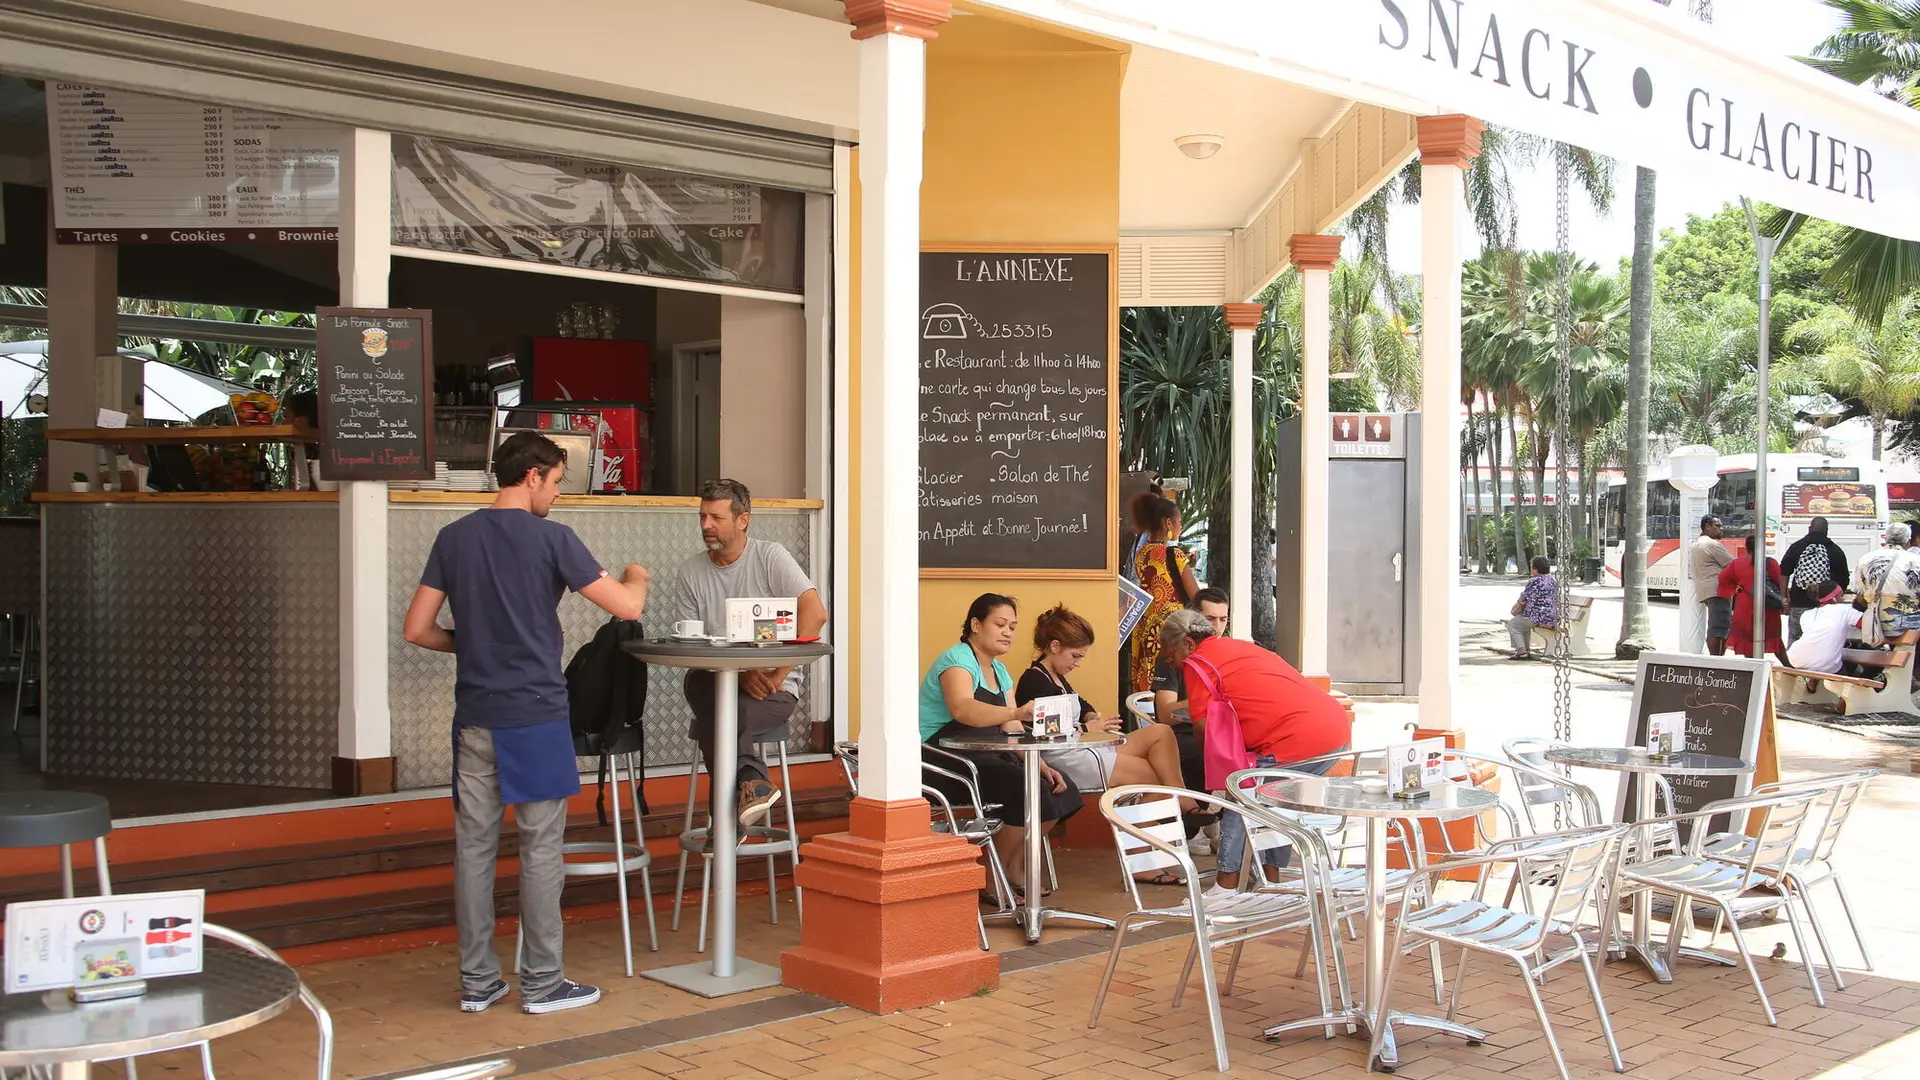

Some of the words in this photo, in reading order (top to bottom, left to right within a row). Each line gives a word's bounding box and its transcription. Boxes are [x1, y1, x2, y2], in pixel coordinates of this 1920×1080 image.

[1378, 0, 1599, 115] SNACK
[1686, 88, 1875, 203] GLACIER
[234, 138, 262, 146] SODAS
[73, 232, 118, 242] Tartes
[170, 231, 226, 242] Cookies
[278, 230, 339, 241] Brownies
[709, 227, 743, 238] Cake
[957, 258, 1073, 282] L'ANNEXE
[334, 317, 348, 328] La
[350, 317, 381, 328] Formule
[386, 318, 410, 329] Snack
[992, 324, 1053, 338] 253315
[1064, 354, 1072, 368] à
[334, 365, 359, 380] Panini
[363, 372, 372, 380] ou
[376, 367, 406, 380] Salade
[339, 384, 369, 396] Boisson
[375, 382, 406, 398] Pression
[938, 378, 969, 395] carte
[973, 382, 992, 400] qui
[996, 379, 1036, 401] change
[1041, 378, 1065, 394] tous
[1068, 379, 1082, 395] les
[1079, 384, 1107, 403] jours
[350, 408, 380, 418] Dessert
[932, 406, 972, 423] Snack
[1059, 410, 1083, 423] sur
[952, 433, 969, 443] ou
[975, 429, 983, 442] à
[1334, 444, 1390, 455] TOILETTES
[1044, 465, 1060, 483] de
[1060, 464, 1093, 483] Thé
[992, 491, 1038, 504] maison
[933, 521, 976, 546] Appétit
[982, 518, 993, 536] et
[996, 517, 1030, 536] Bonne
[1665, 577, 1678, 586] BUS
[1118, 600, 1144, 633] GRAFFITI
[1652, 666, 1666, 682] Le
[1666, 667, 1692, 685] Brunch
[1694, 670, 1703, 686] du
[1705, 670, 1737, 689] Samedi
[1684, 718, 1712, 736] Chaude
[1671, 787, 1692, 804] Bacon
